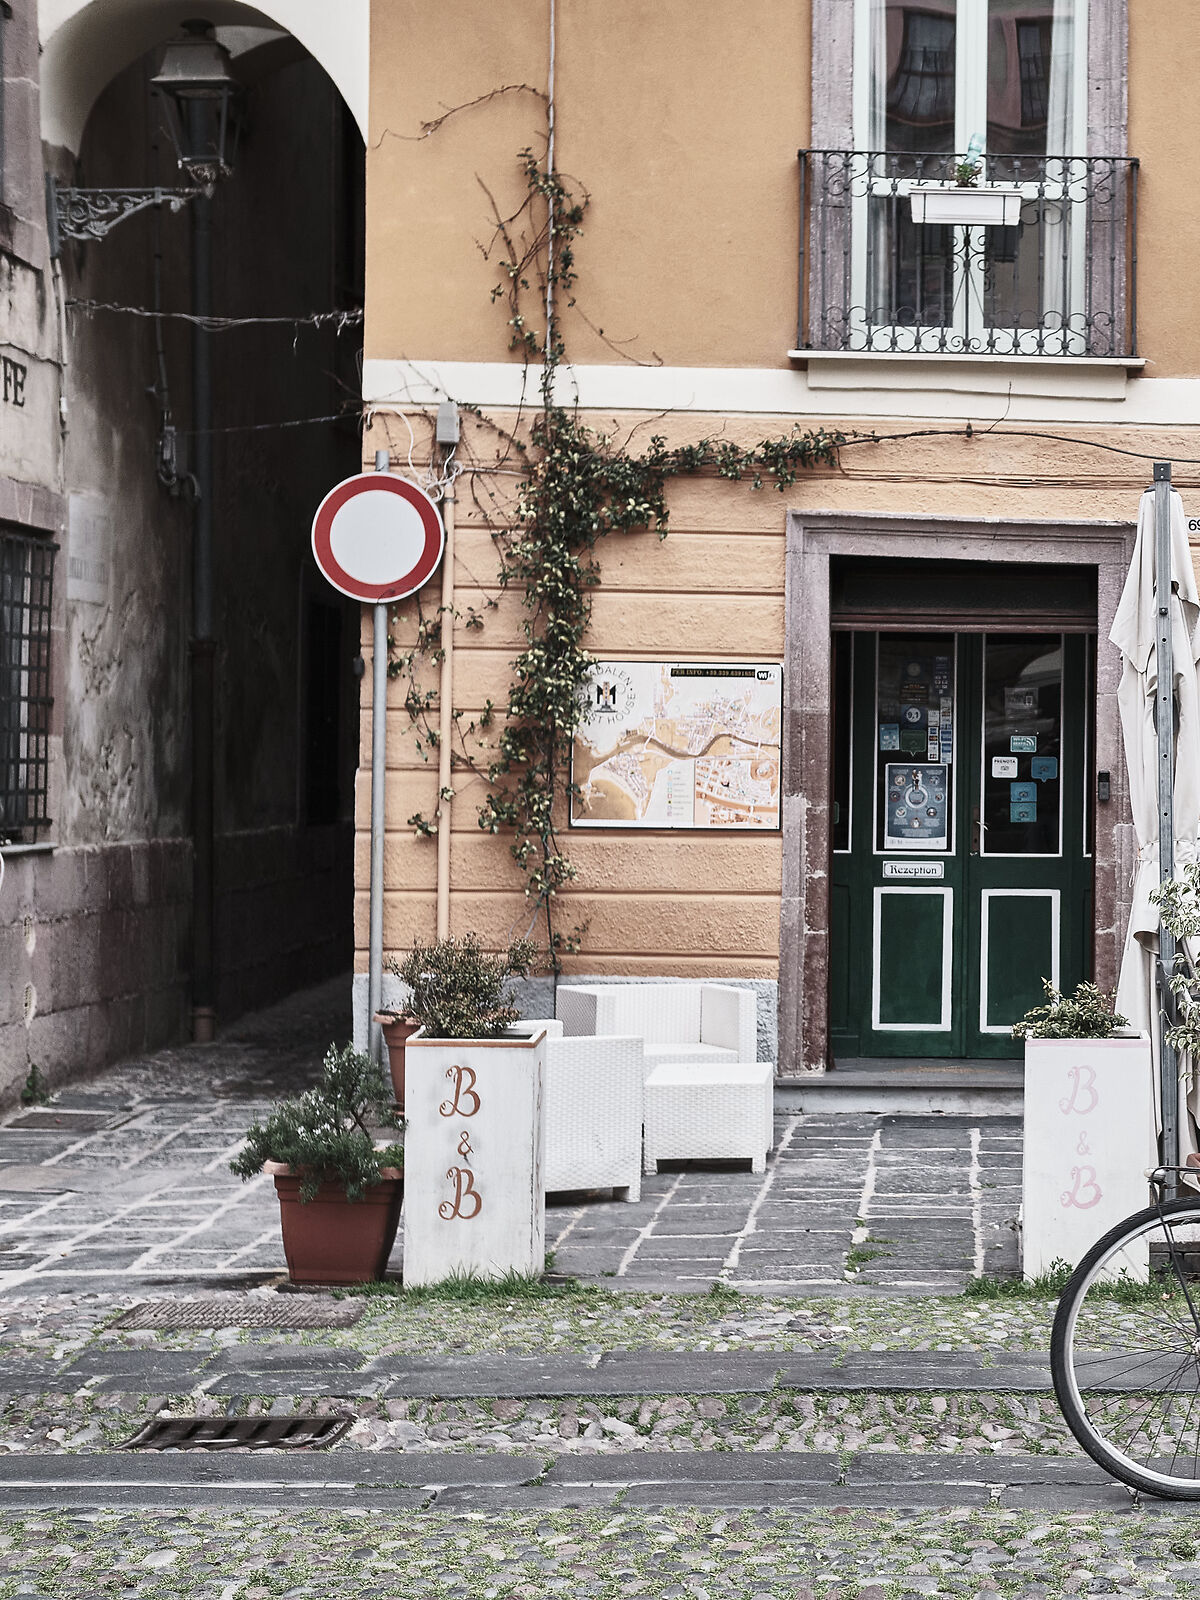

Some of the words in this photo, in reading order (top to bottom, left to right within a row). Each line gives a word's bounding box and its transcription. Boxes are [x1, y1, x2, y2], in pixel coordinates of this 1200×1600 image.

[0, 355, 27, 408] FE
[589, 666, 632, 686] ADALEN
[607, 693, 636, 725] HOUSE
[439, 1065, 481, 1118] B
[1058, 1065, 1099, 1116] B
[457, 1130, 475, 1156] &
[1076, 1130, 1093, 1156] &
[438, 1166, 482, 1221] B
[1060, 1165, 1103, 1210] B
